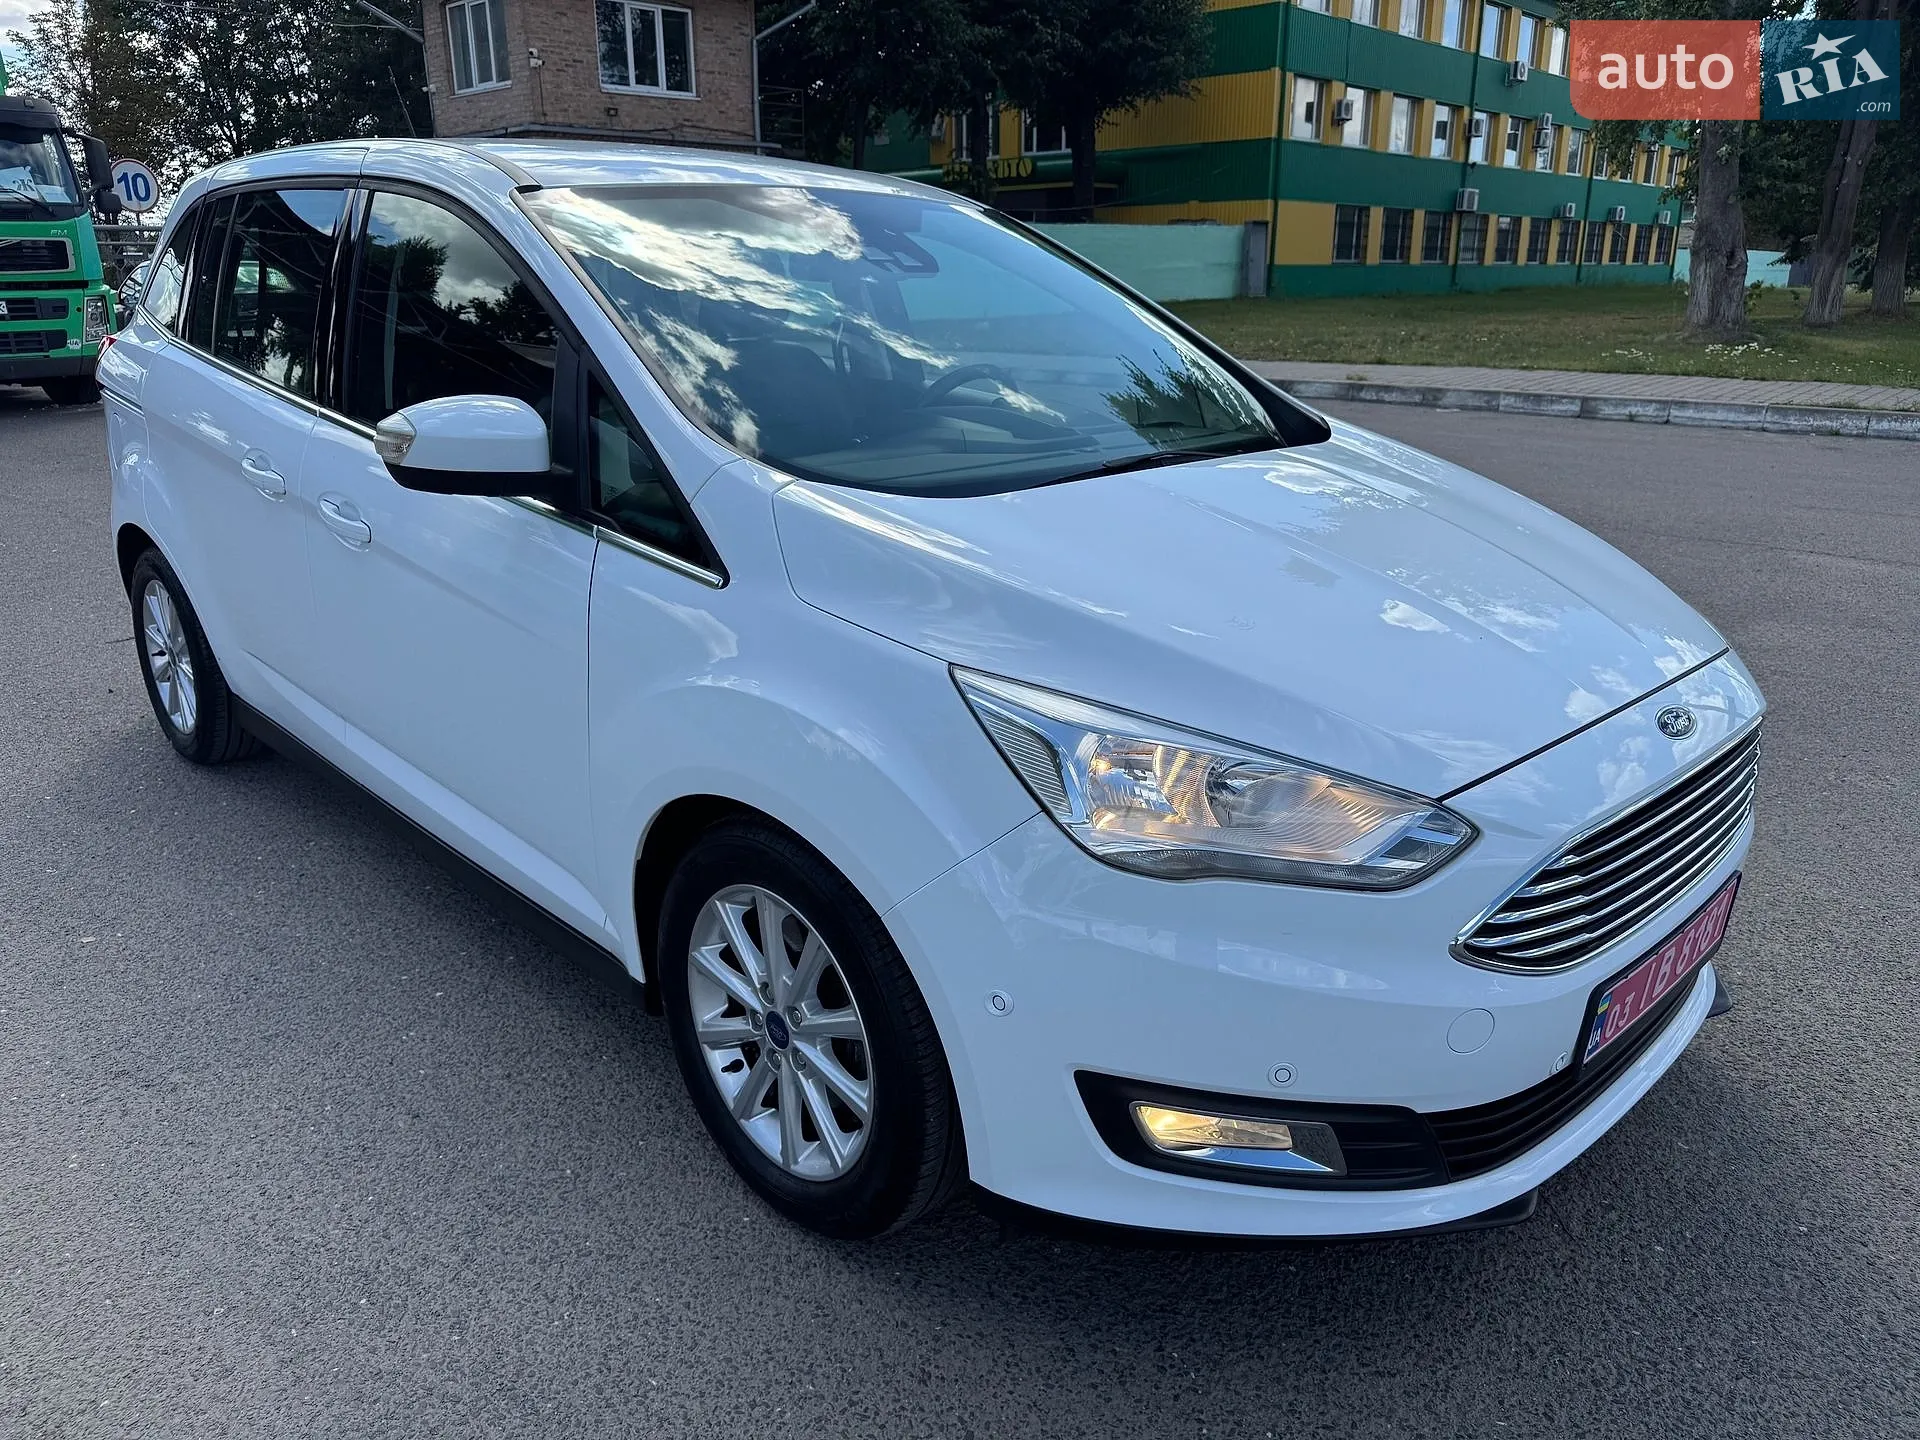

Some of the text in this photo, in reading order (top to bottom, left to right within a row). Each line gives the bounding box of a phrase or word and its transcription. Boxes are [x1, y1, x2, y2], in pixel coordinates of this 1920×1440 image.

[117, 171, 151, 202] 10
[1664, 711, 1690, 734] Ford
[1588, 1027, 1601, 1049] UA
[1605, 992, 1636, 1039] 03
[1675, 892, 1730, 976] 8181
